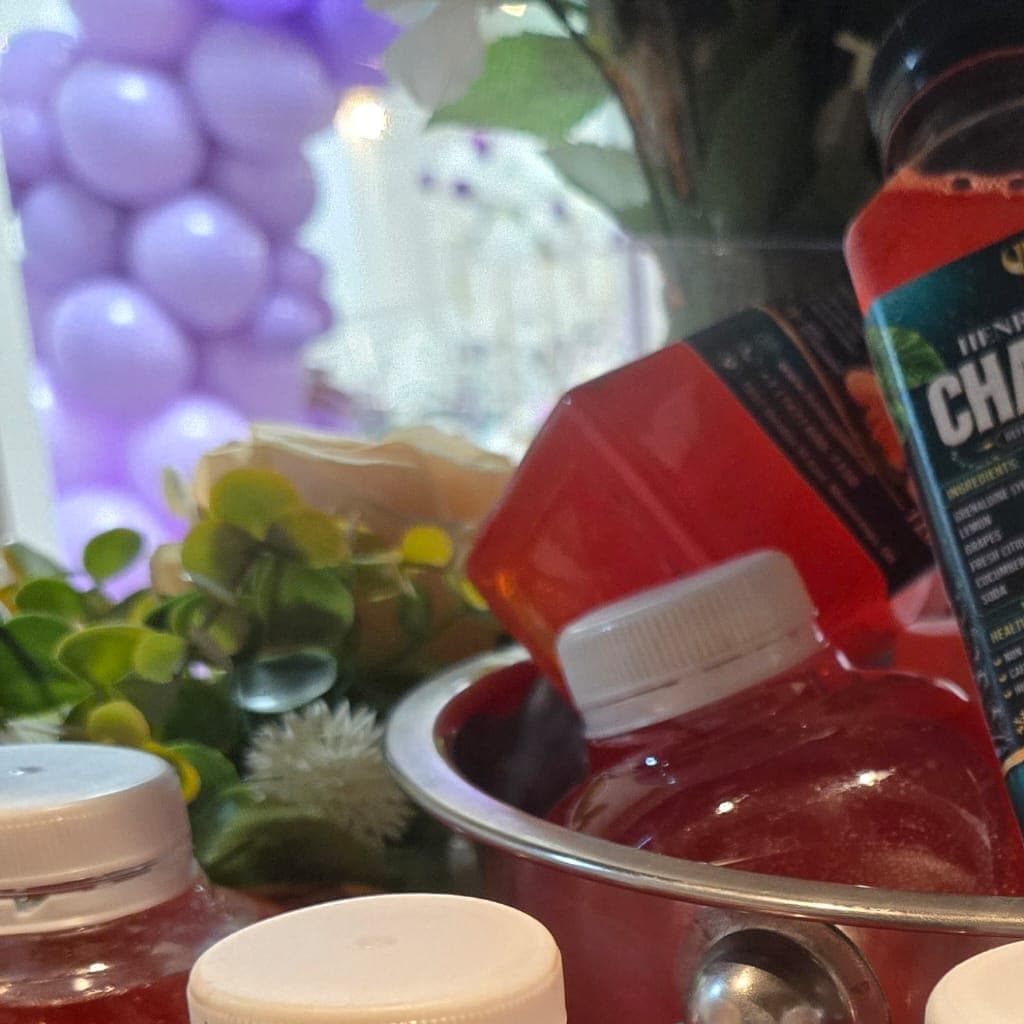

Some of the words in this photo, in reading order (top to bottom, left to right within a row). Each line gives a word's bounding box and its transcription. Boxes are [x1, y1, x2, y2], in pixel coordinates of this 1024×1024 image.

[958, 514, 993, 540] LEMON
[964, 529, 1003, 556] GRAPES
[969, 551, 1000, 573] FRESH
[980, 584, 1008, 606] SODA
[1003, 647, 1023, 663] NON
